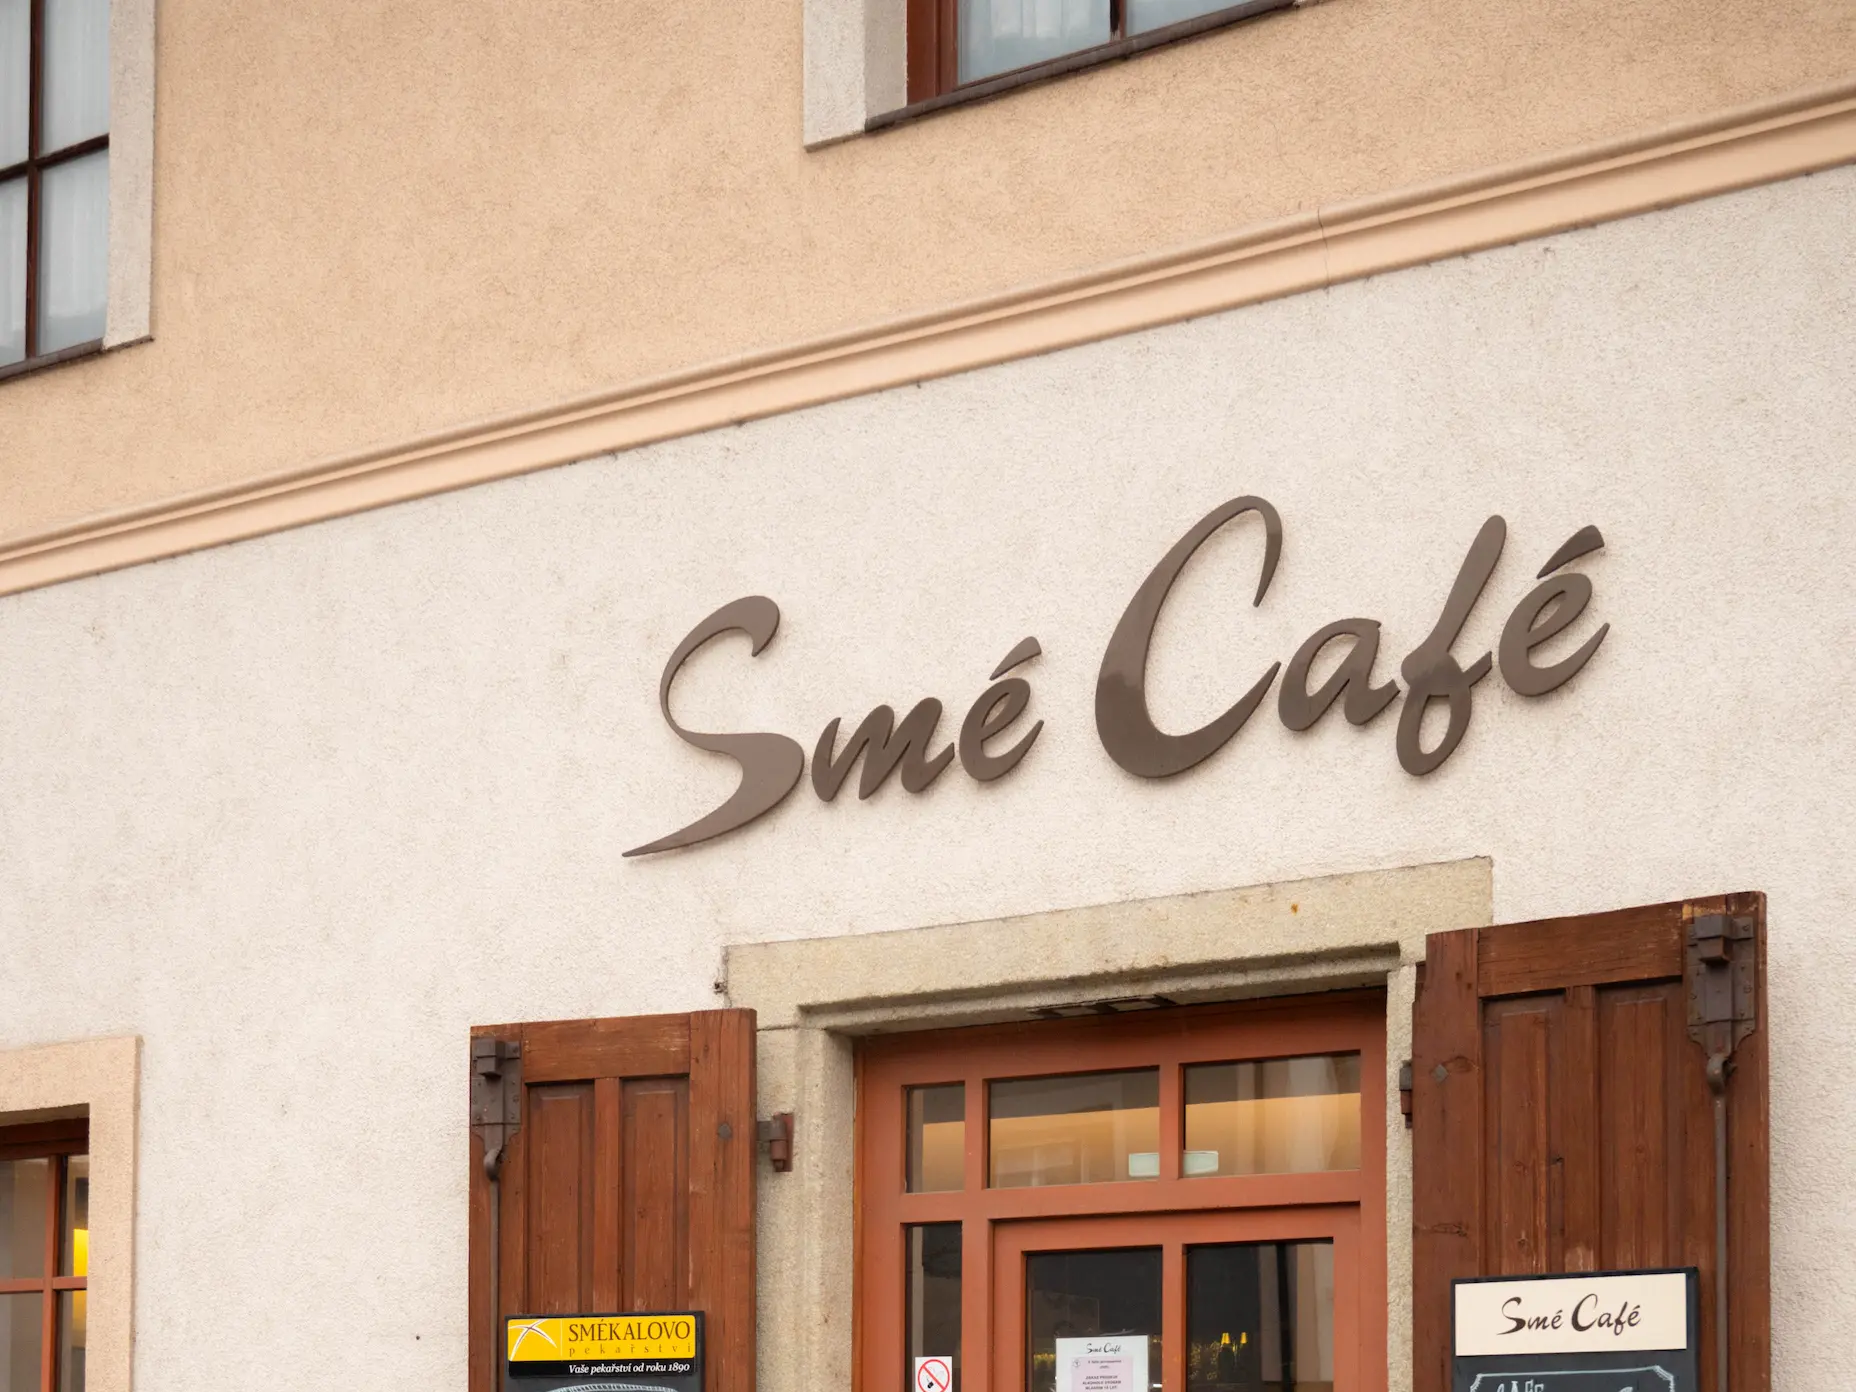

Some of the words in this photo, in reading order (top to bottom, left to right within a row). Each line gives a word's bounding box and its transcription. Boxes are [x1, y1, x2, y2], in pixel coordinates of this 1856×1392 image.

[622, 595, 1045, 858] Smé
[1095, 494, 1610, 777] Café
[568, 1318, 691, 1342] SMÉKALOVO
[1496, 1296, 1563, 1336] Smé
[1571, 1293, 1641, 1336] Café
[568, 1363, 589, 1374] Vaše
[590, 1362, 632, 1375] pekařství
[633, 1362, 645, 1372] od
[646, 1362, 666, 1372] roku
[668, 1361, 691, 1373] 1890
